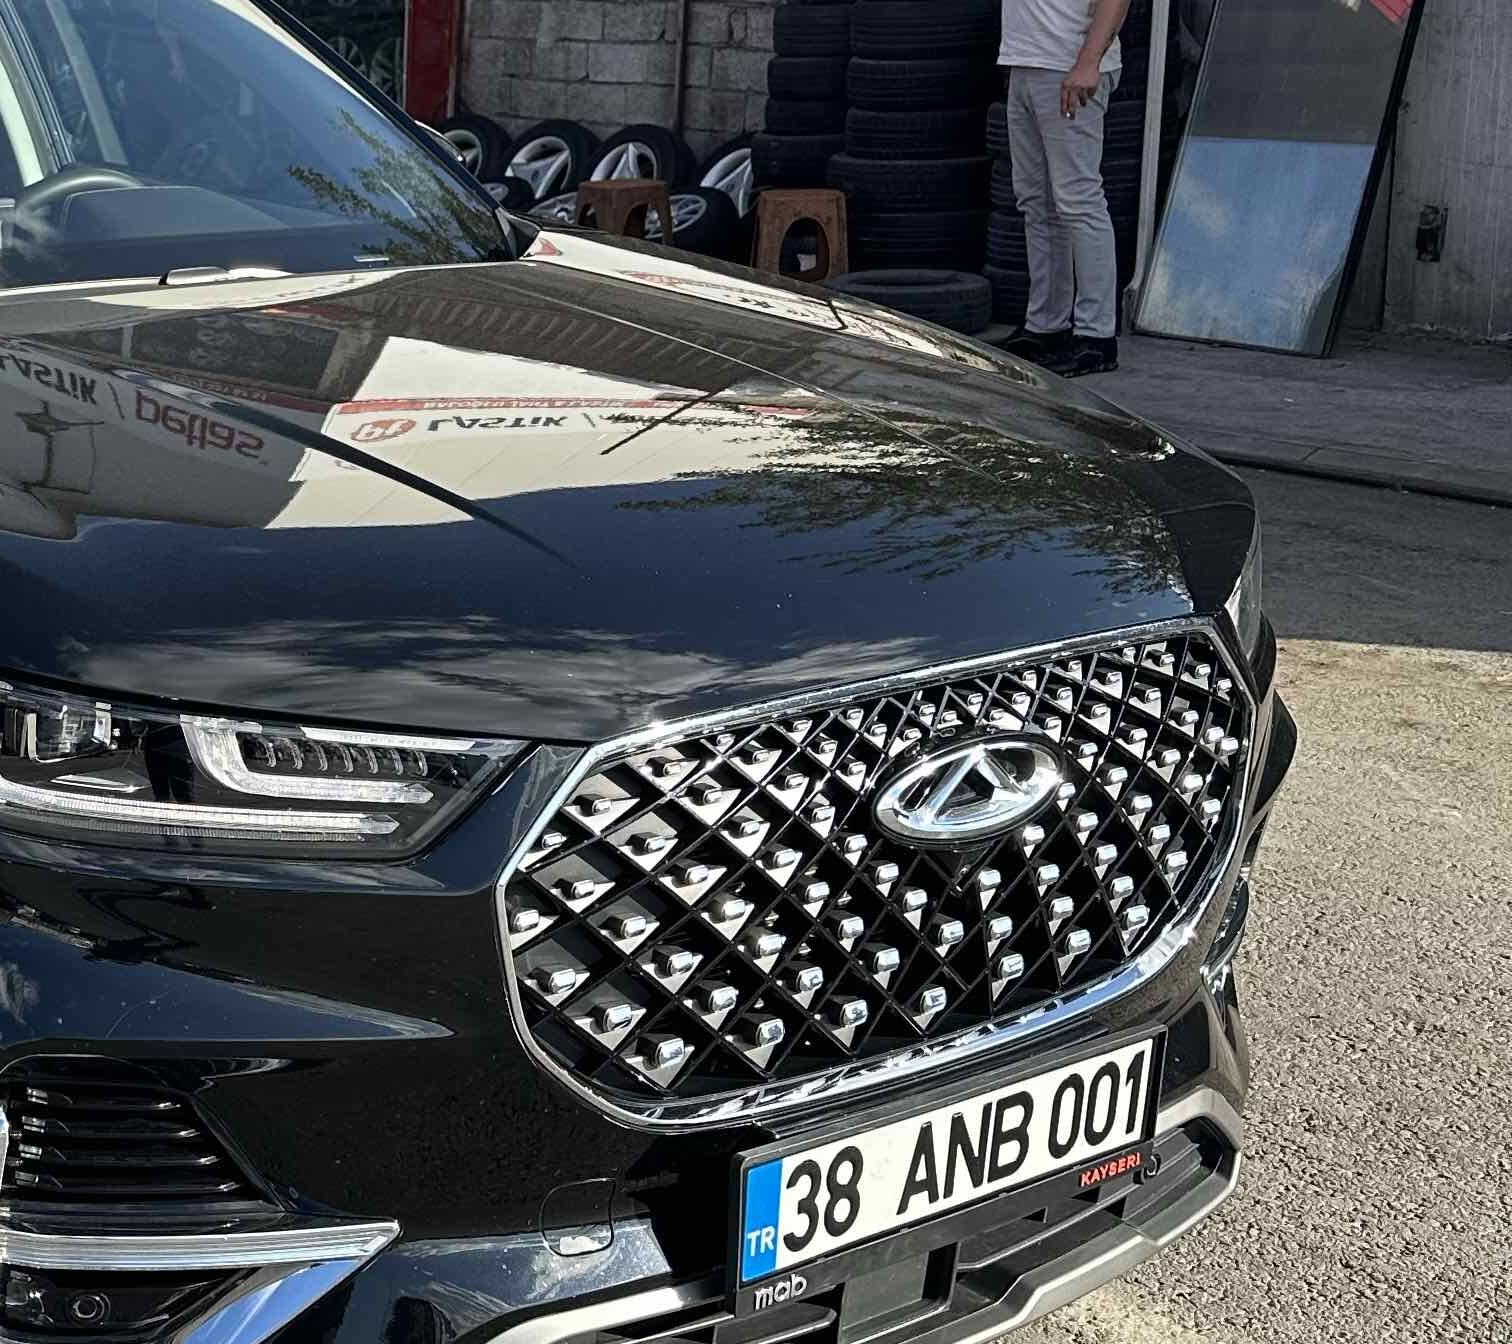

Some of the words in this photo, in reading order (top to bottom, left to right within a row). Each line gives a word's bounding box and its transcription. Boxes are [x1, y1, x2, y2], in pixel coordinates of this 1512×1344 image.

[747, 1224, 776, 1257] TR
[783, 1145, 865, 1253] 38
[896, 1089, 1035, 1216] ANB
[1047, 1049, 1147, 1160] 001
[754, 1272, 808, 1311] mab
